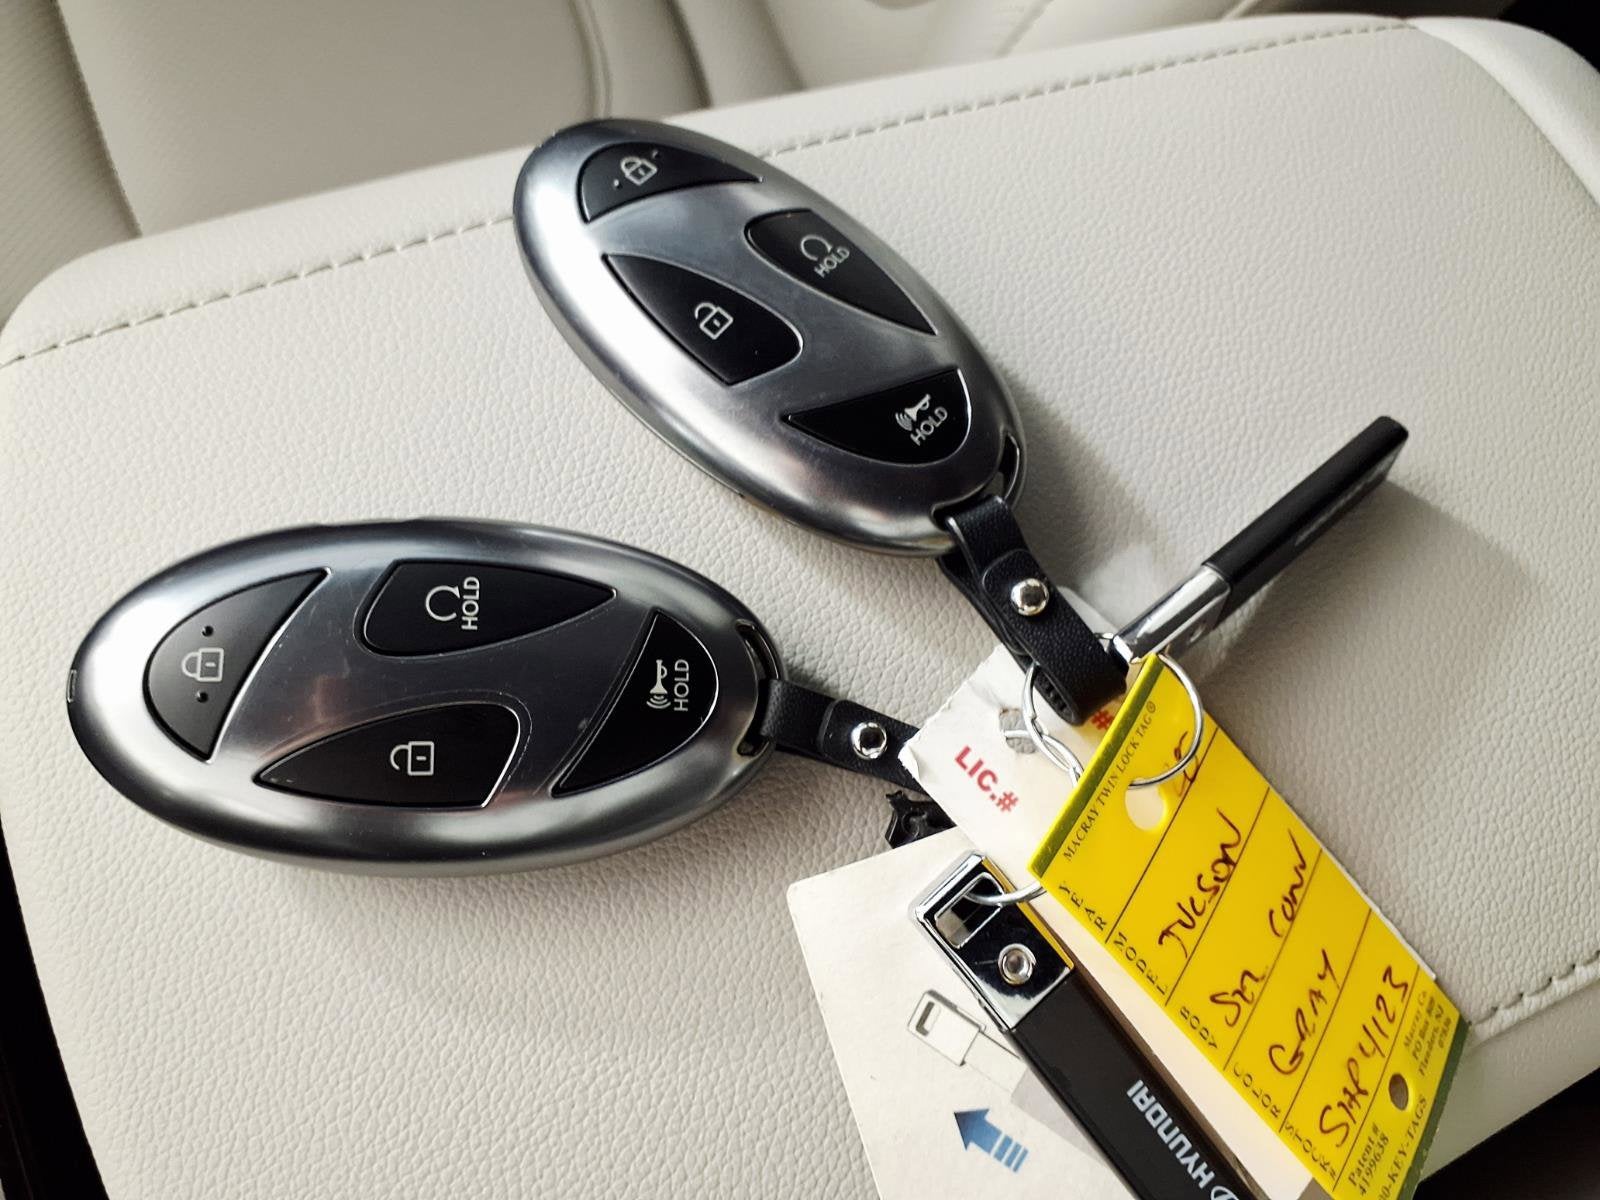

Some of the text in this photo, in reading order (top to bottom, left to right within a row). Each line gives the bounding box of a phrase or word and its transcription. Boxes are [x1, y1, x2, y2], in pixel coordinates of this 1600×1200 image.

[814, 246, 850, 279] HOLD
[910, 406, 948, 446] HOLD
[461, 576, 480, 631] HOLD
[674, 658, 690, 712] HOLD
[1063, 807, 1100, 861] MACRAY
[1096, 773, 1119, 807] TWIN
[1116, 738, 1140, 773] LOCK
[1059, 881, 1107, 931] YEAR
[1114, 931, 1168, 996] MODEL
[1180, 1005, 1218, 1049] BODY
[1233, 1062, 1281, 1119] COLOR
[1126, 1079, 1215, 1190] HYUNDAI
[1348, 1135, 1376, 1187] Patent
